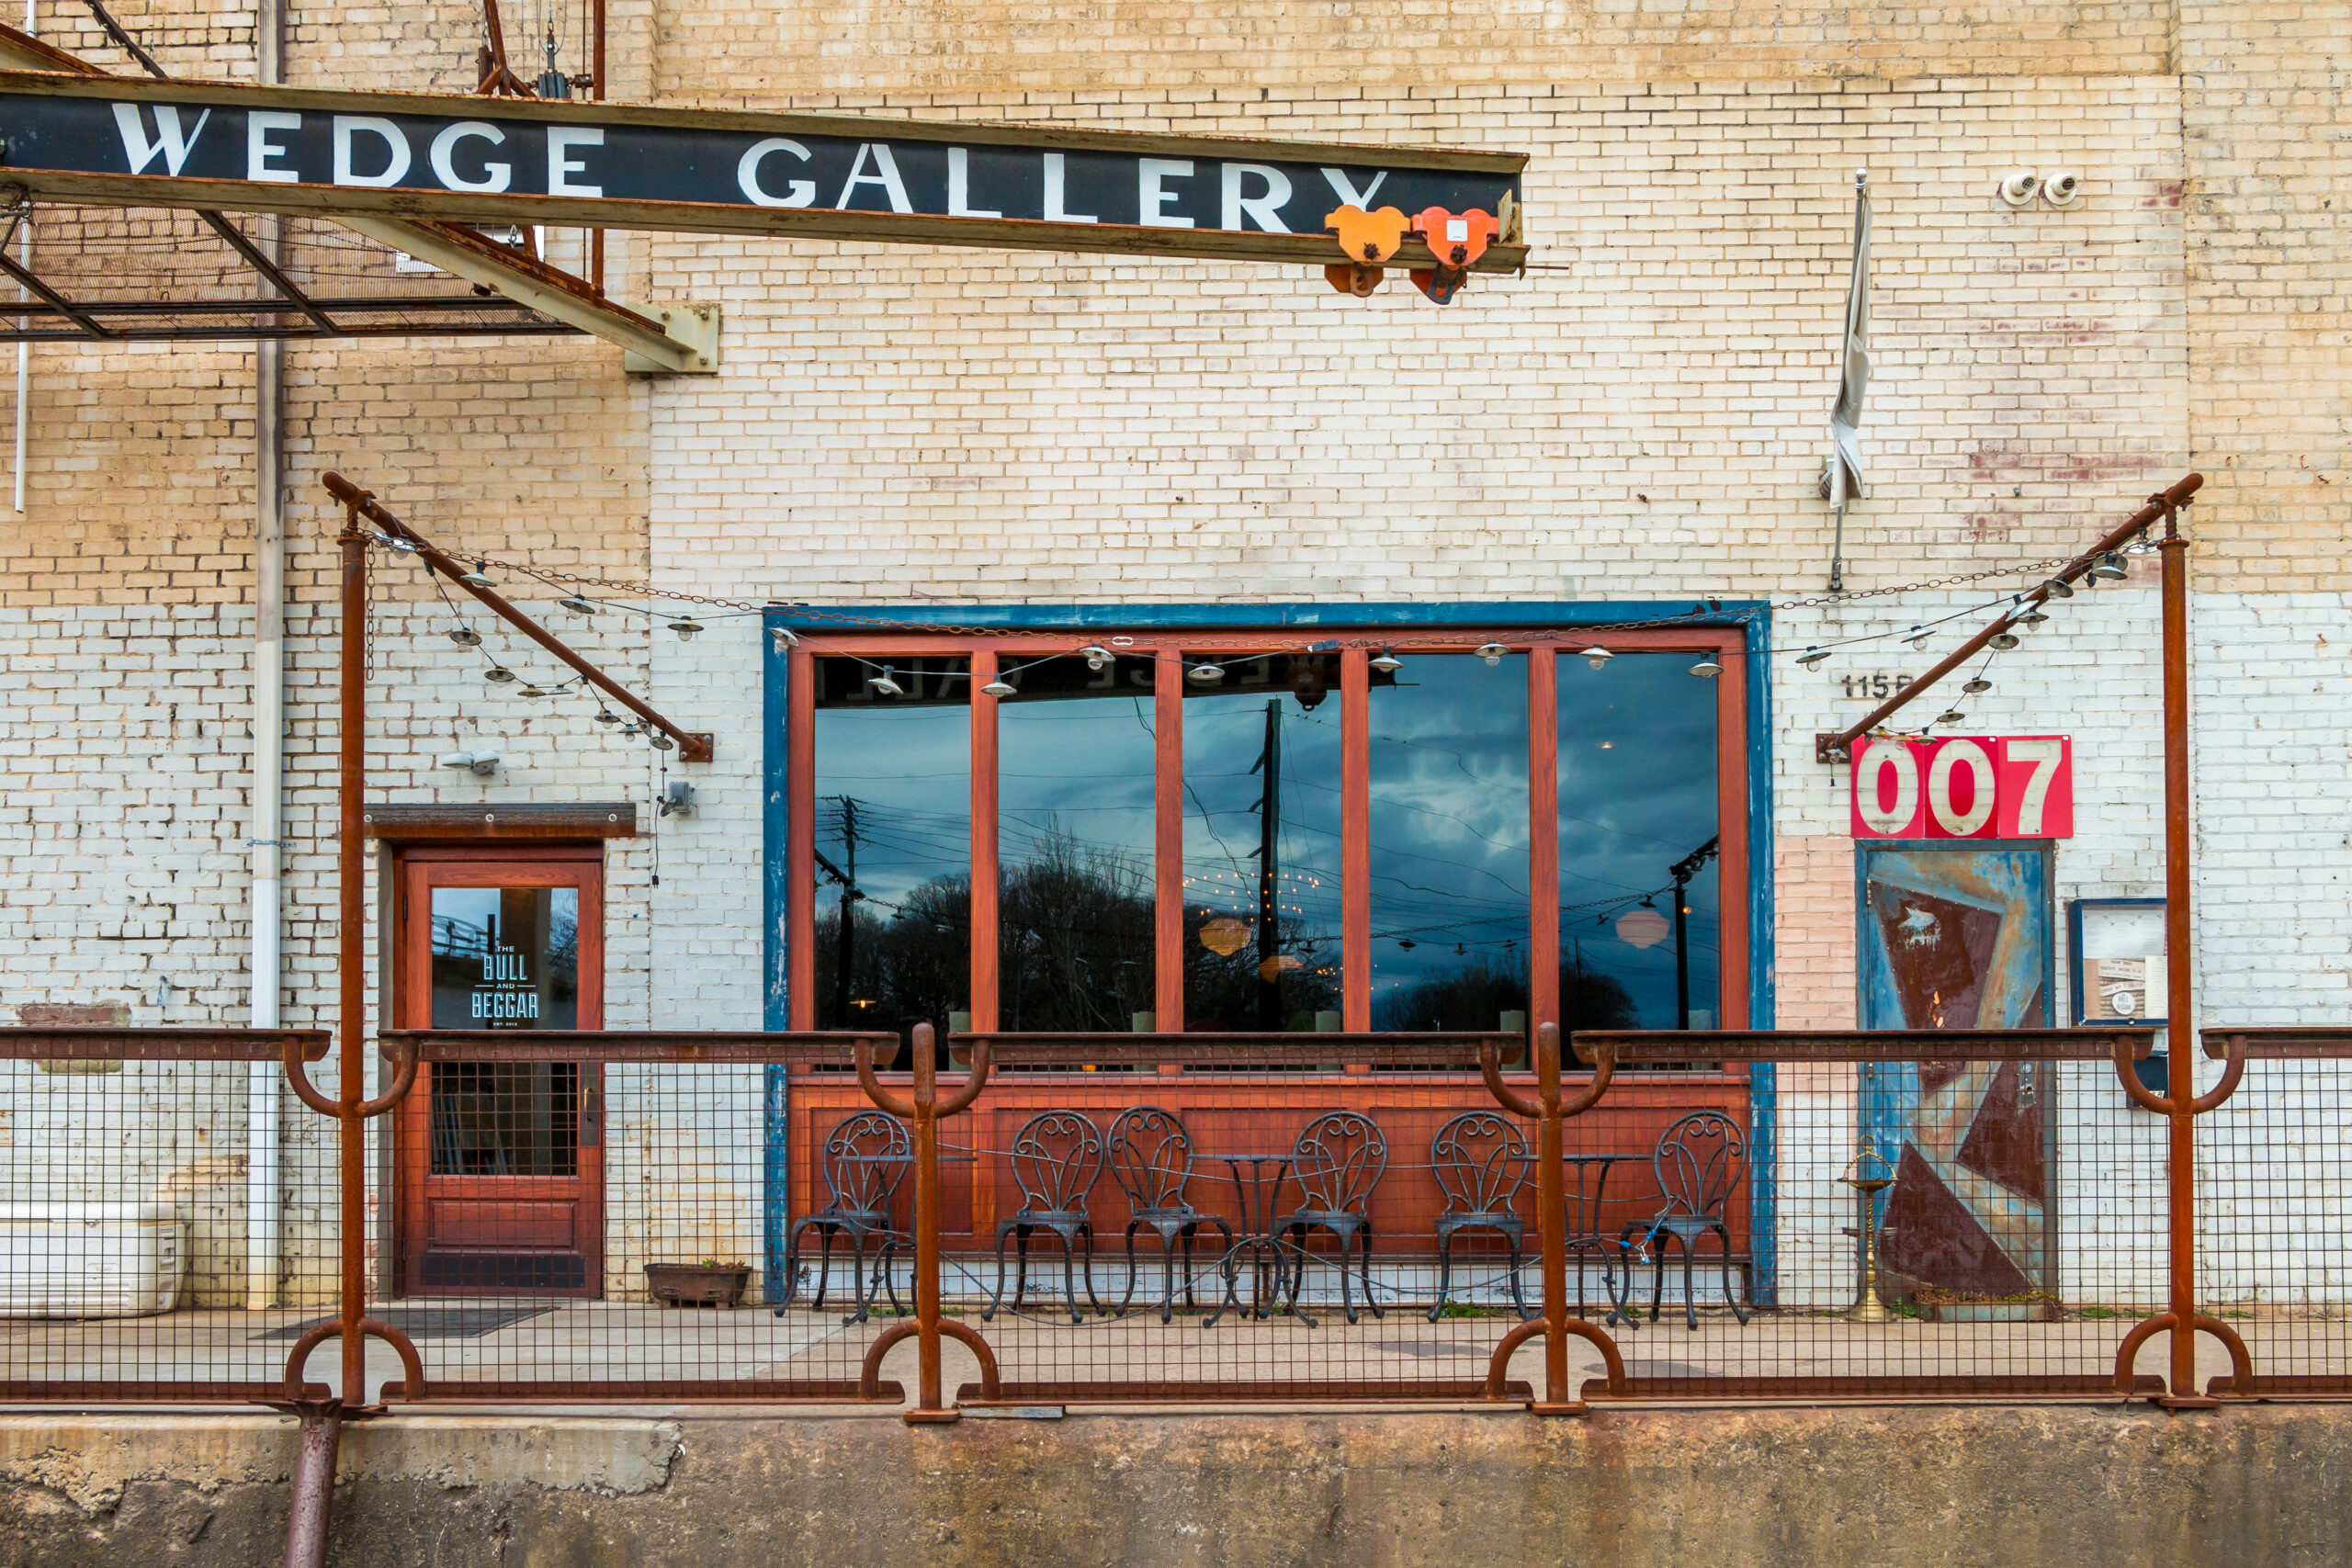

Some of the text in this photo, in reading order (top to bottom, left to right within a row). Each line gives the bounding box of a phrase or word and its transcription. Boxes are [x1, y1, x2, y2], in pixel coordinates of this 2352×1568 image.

[111, 102, 1388, 235] WEDGE GALLERY
[1857, 739, 2062, 836] 007
[483, 954, 527, 981] BULL
[471, 992, 539, 1019] BEGGAR
